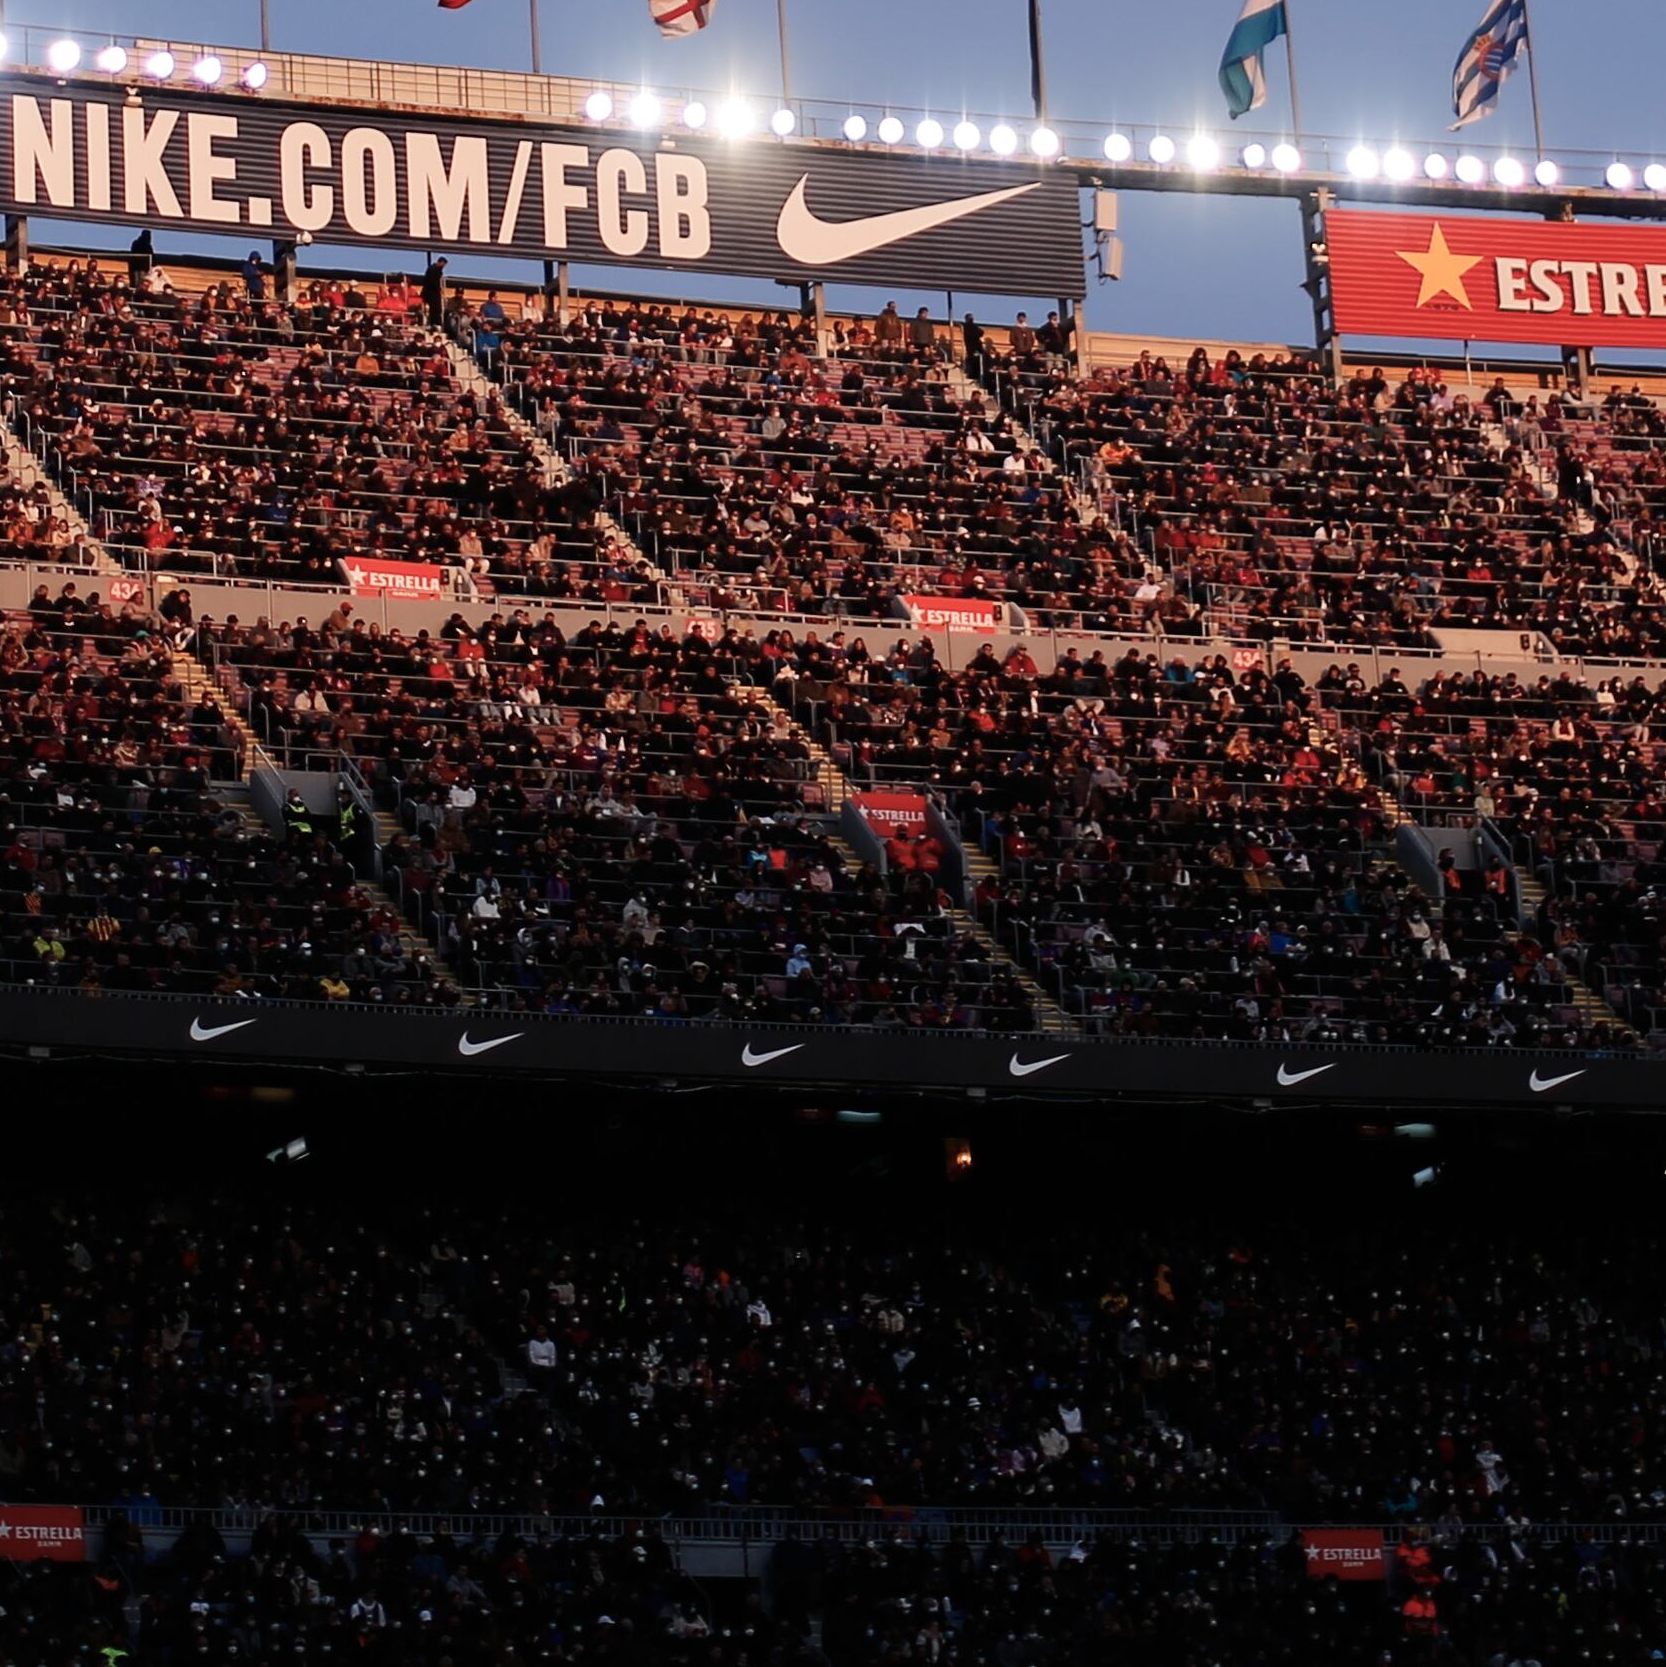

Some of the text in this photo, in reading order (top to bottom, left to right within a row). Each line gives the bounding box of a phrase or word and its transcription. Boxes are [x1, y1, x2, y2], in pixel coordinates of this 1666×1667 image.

[12, 94, 711, 259] NIKE.COM/FCB
[369, 573, 440, 591] ESTRELLA
[926, 609, 994, 627] ESTRELLA
[15, 1525, 83, 1541] ESTRELLA
[1323, 1548, 1382, 1561] ESTRELLA
